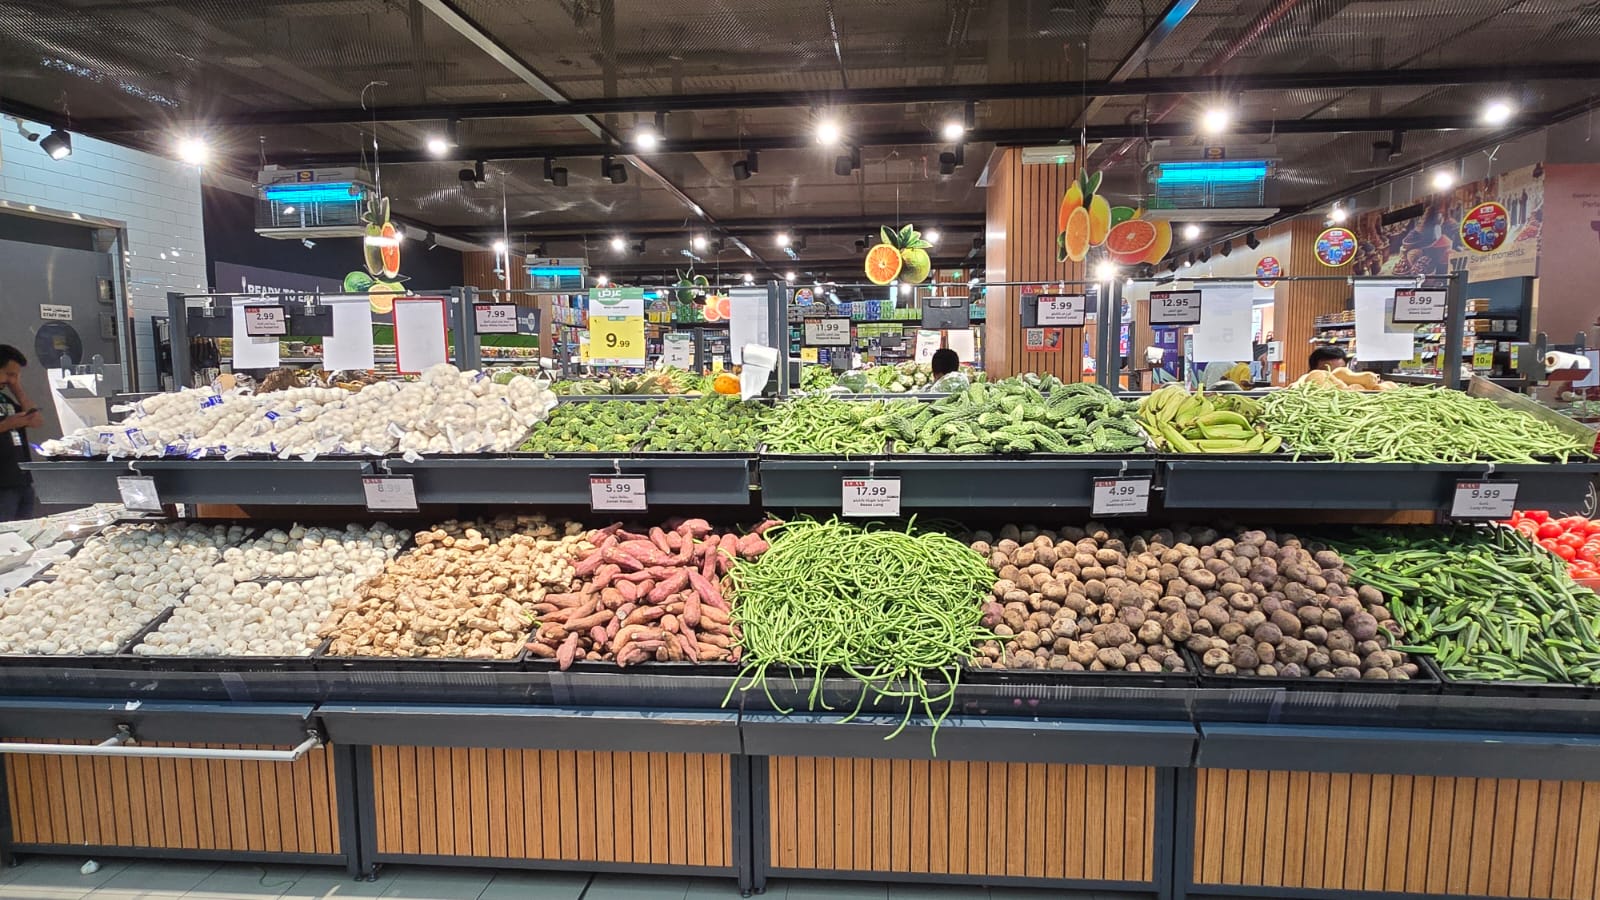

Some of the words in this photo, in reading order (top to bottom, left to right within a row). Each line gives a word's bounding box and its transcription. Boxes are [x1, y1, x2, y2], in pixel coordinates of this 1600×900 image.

[248, 284, 281, 295] READY
[598, 288, 622, 298] عرض
[1162, 298, 1189, 307] 12.95
[1409, 296, 1432, 305] 8.99
[1050, 301, 1072, 310] 5.99
[256, 312, 274, 320] 2.99
[487, 310, 505, 318] 7.99
[816, 323, 839, 332] 11.99
[606, 483, 631, 493] 5.99
[856, 486, 887, 496] 17.99
[1109, 486, 1135, 496] 4.99
[1471, 489, 1500, 499] 9.99
